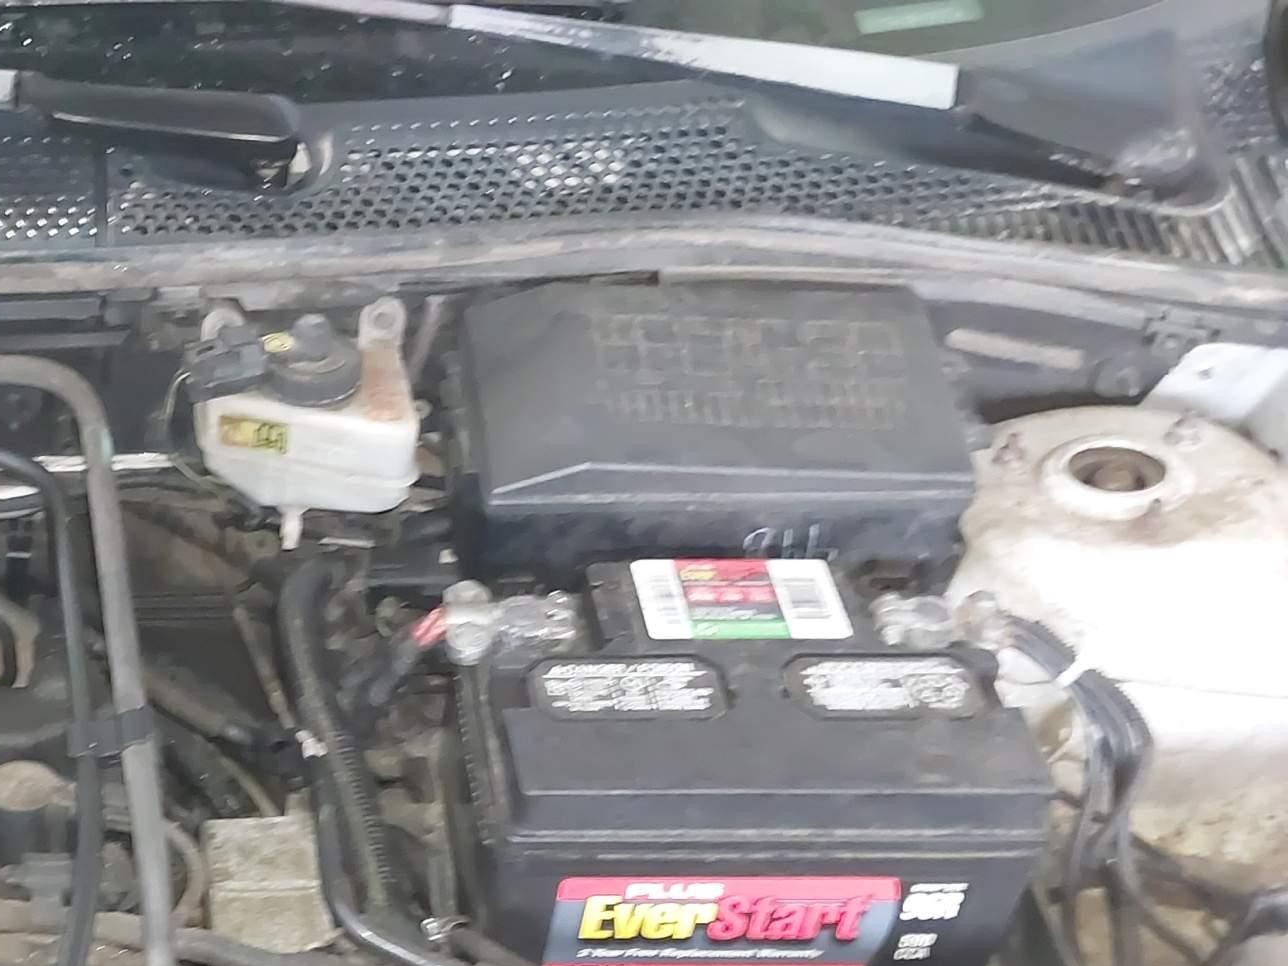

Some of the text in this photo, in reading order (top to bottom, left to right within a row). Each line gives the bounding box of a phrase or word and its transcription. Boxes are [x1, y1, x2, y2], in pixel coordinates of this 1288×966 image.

[624, 882, 726, 900] PLUS
[577, 894, 873, 942] EverStart
[592, 948, 626, 959] Year
[658, 947, 760, 960] Replacement
[756, 948, 825, 960] Warranty
